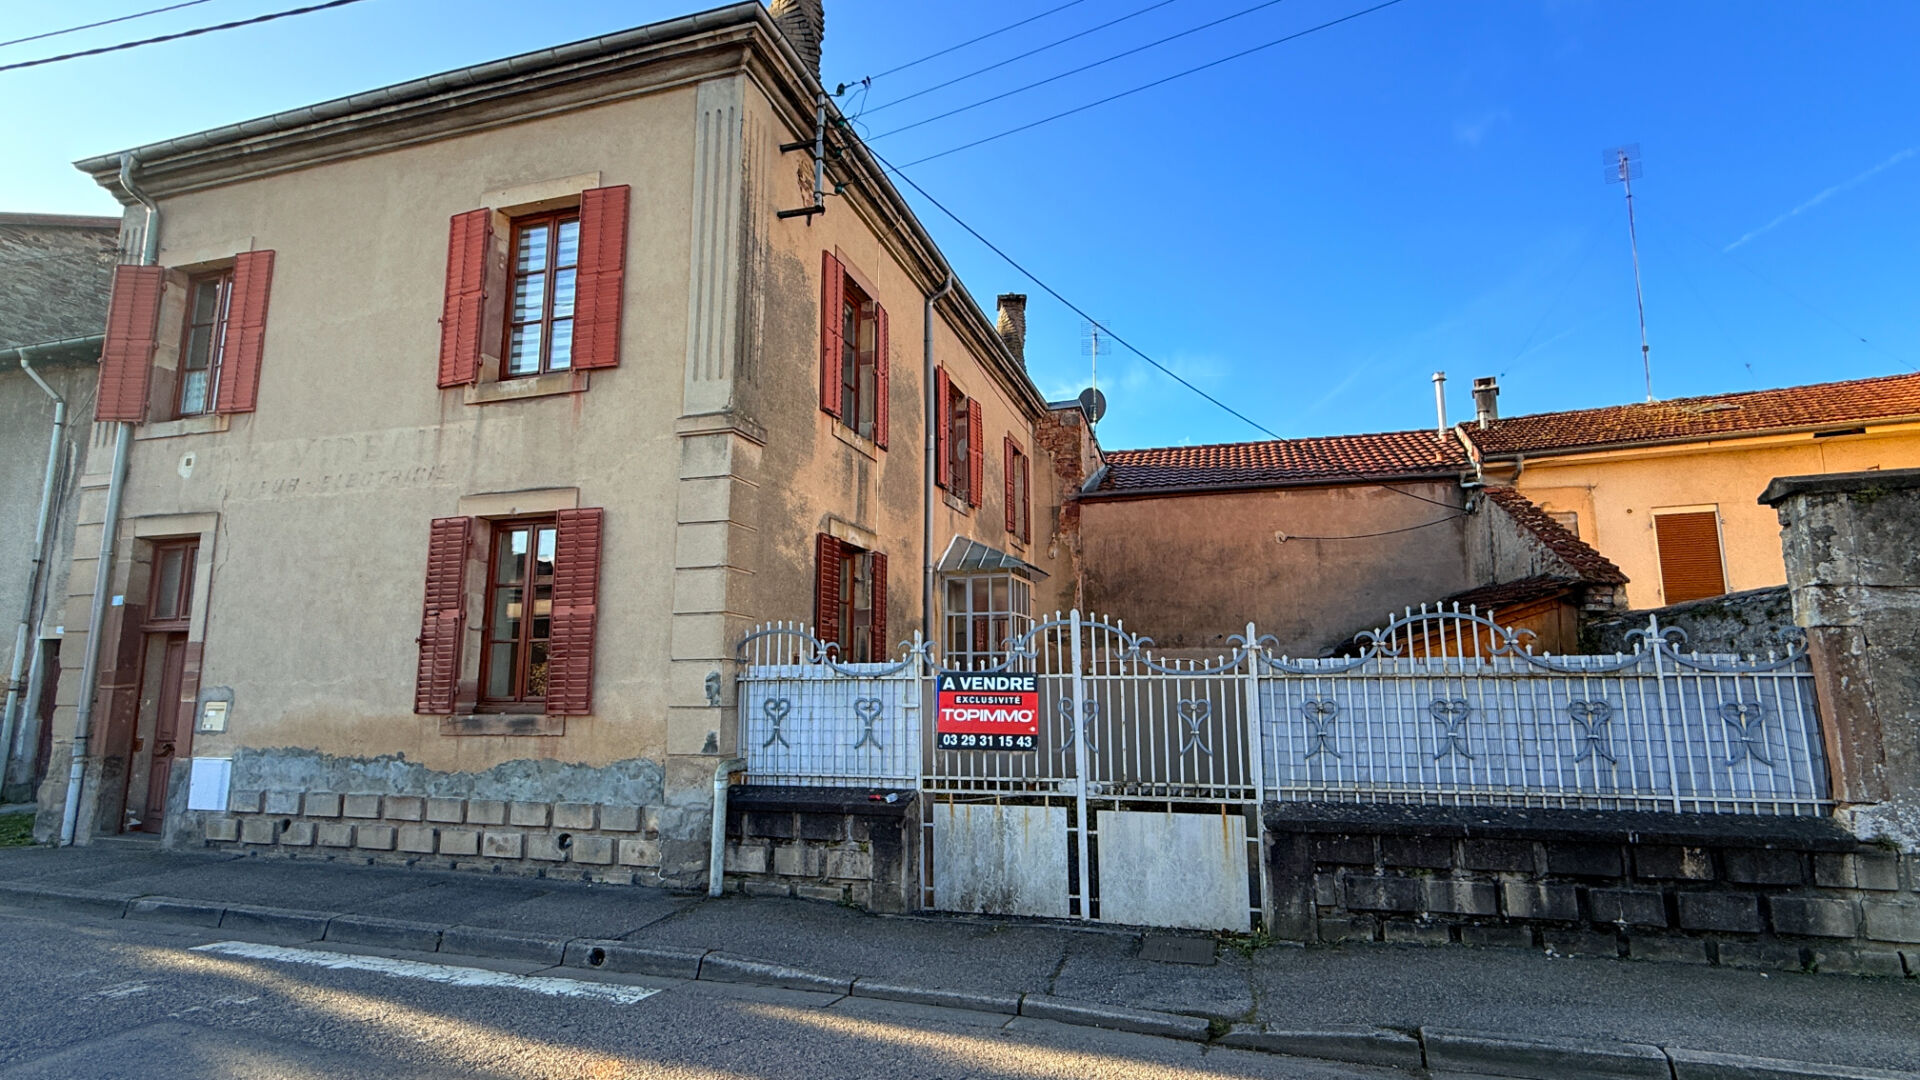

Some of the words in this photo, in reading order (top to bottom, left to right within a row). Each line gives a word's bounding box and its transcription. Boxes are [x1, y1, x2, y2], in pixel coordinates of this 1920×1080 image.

[943, 677, 956, 690] A
[959, 677, 1035, 690] VENDRE
[955, 695, 1021, 704] EXCLUSIVITÉ
[941, 708, 1033, 723] TOPIMMO
[943, 734, 958, 746] 03
[961, 735, 976, 746] 29
[979, 735, 993, 746] 31
[999, 736, 1013, 747] 15
[1016, 736, 1032, 747] 43
